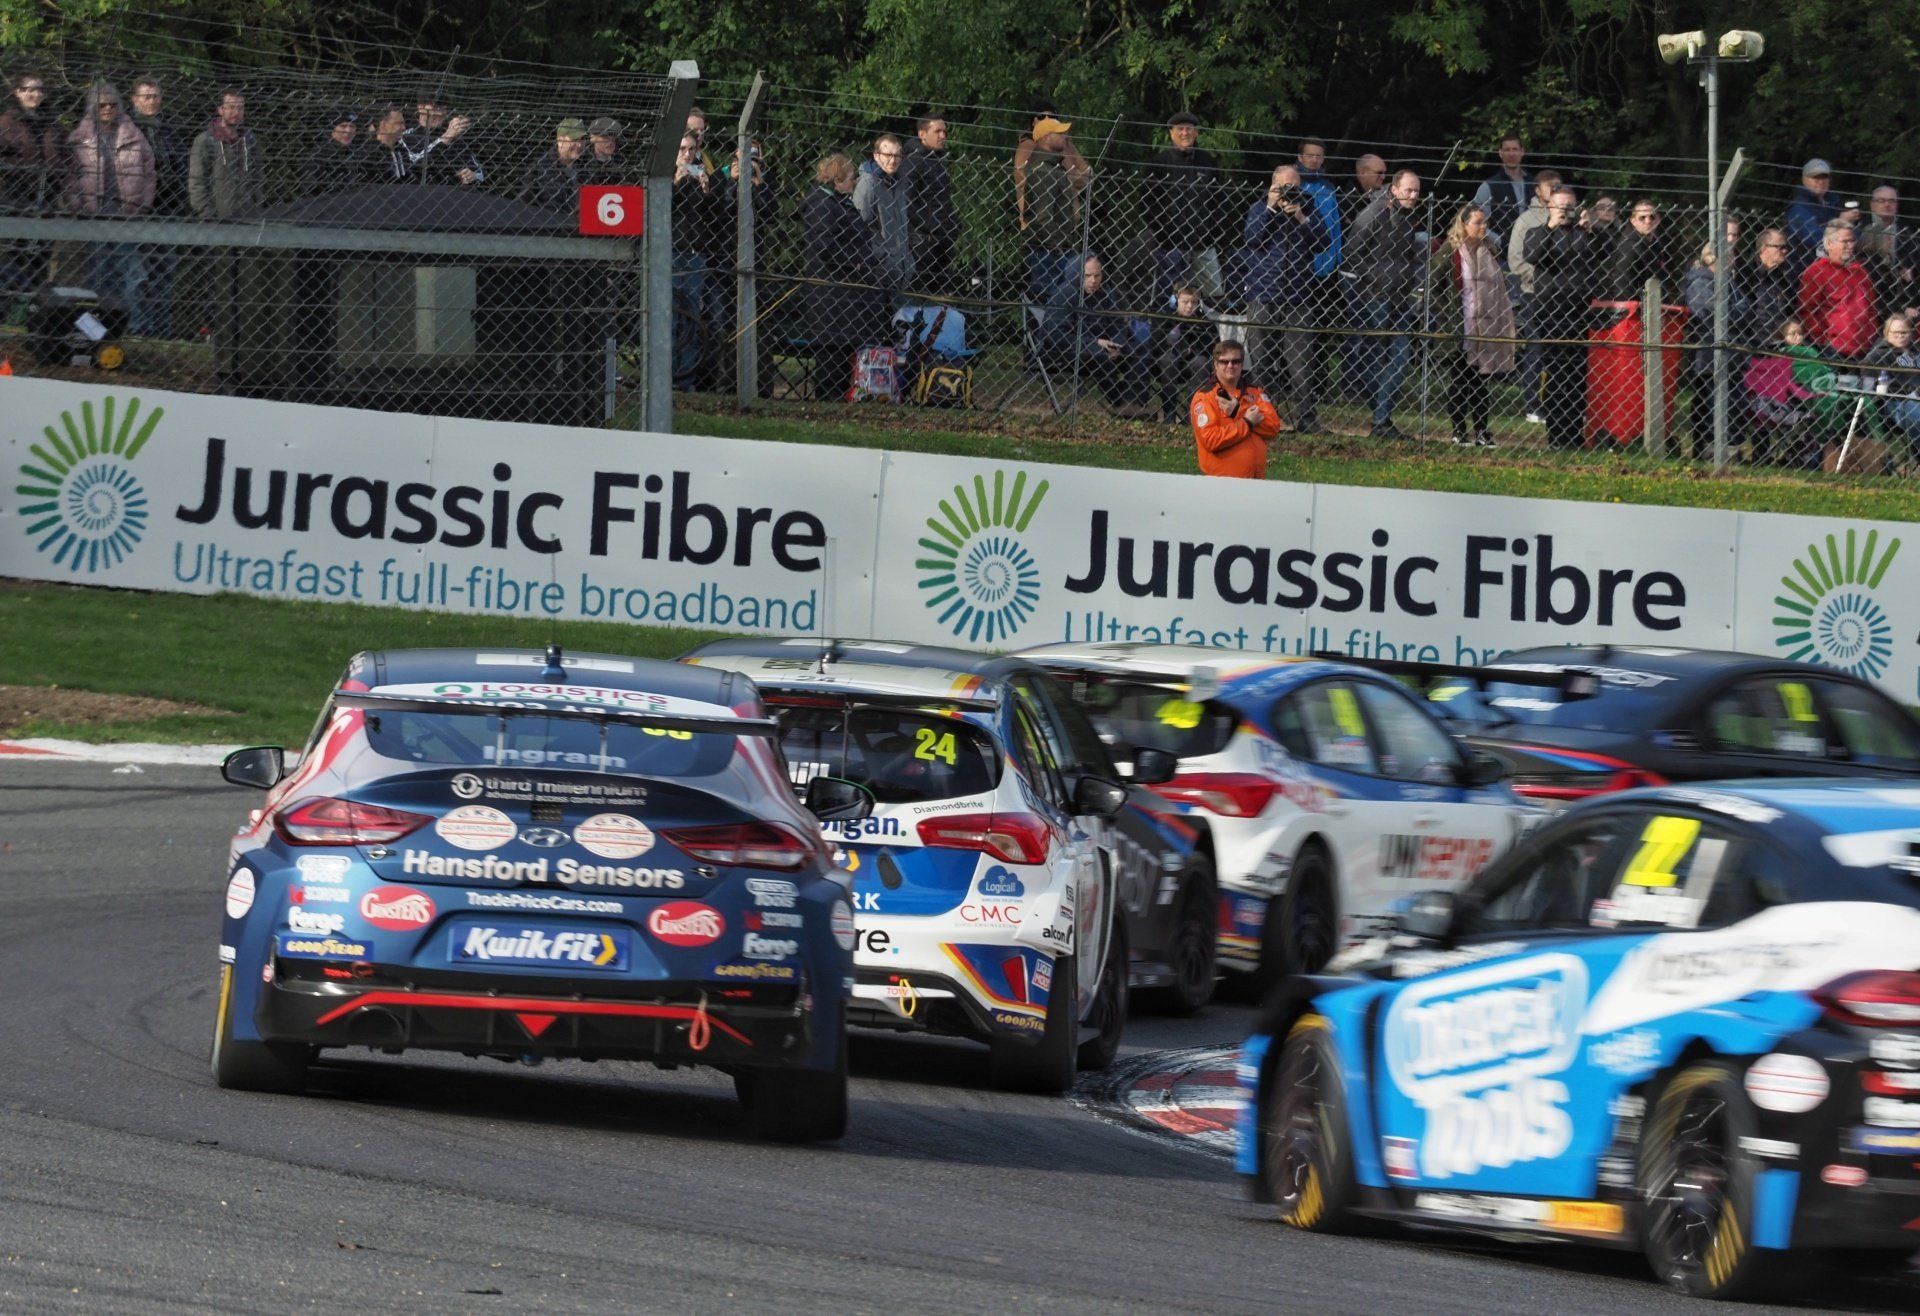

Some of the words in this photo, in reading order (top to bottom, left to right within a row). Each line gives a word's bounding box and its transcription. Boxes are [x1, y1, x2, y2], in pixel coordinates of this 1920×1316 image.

[597, 193, 625, 226] 6
[176, 437, 564, 554] Jurassic
[590, 470, 826, 572] Fibre
[1065, 510, 1439, 617] Jurassic
[1463, 534, 1686, 631] Fibre
[174, 541, 364, 599] Ultrafast
[379, 558, 565, 614] full-fibre
[581, 573, 817, 632] broadband
[482, 683, 669, 704] LOGISTICS
[483, 745, 627, 769] Ingram
[914, 728, 957, 765] 24
[485, 777, 532, 792] third
[913, 800, 984, 815] Diamondbrite
[403, 849, 548, 883] Hansford
[556, 858, 685, 890] Sensors
[985, 881, 1016, 894] Logicall
[465, 891, 624, 914] TradePriceCars.com
[960, 905, 1022, 924] CMC
[1042, 925, 1067, 943] alcon
